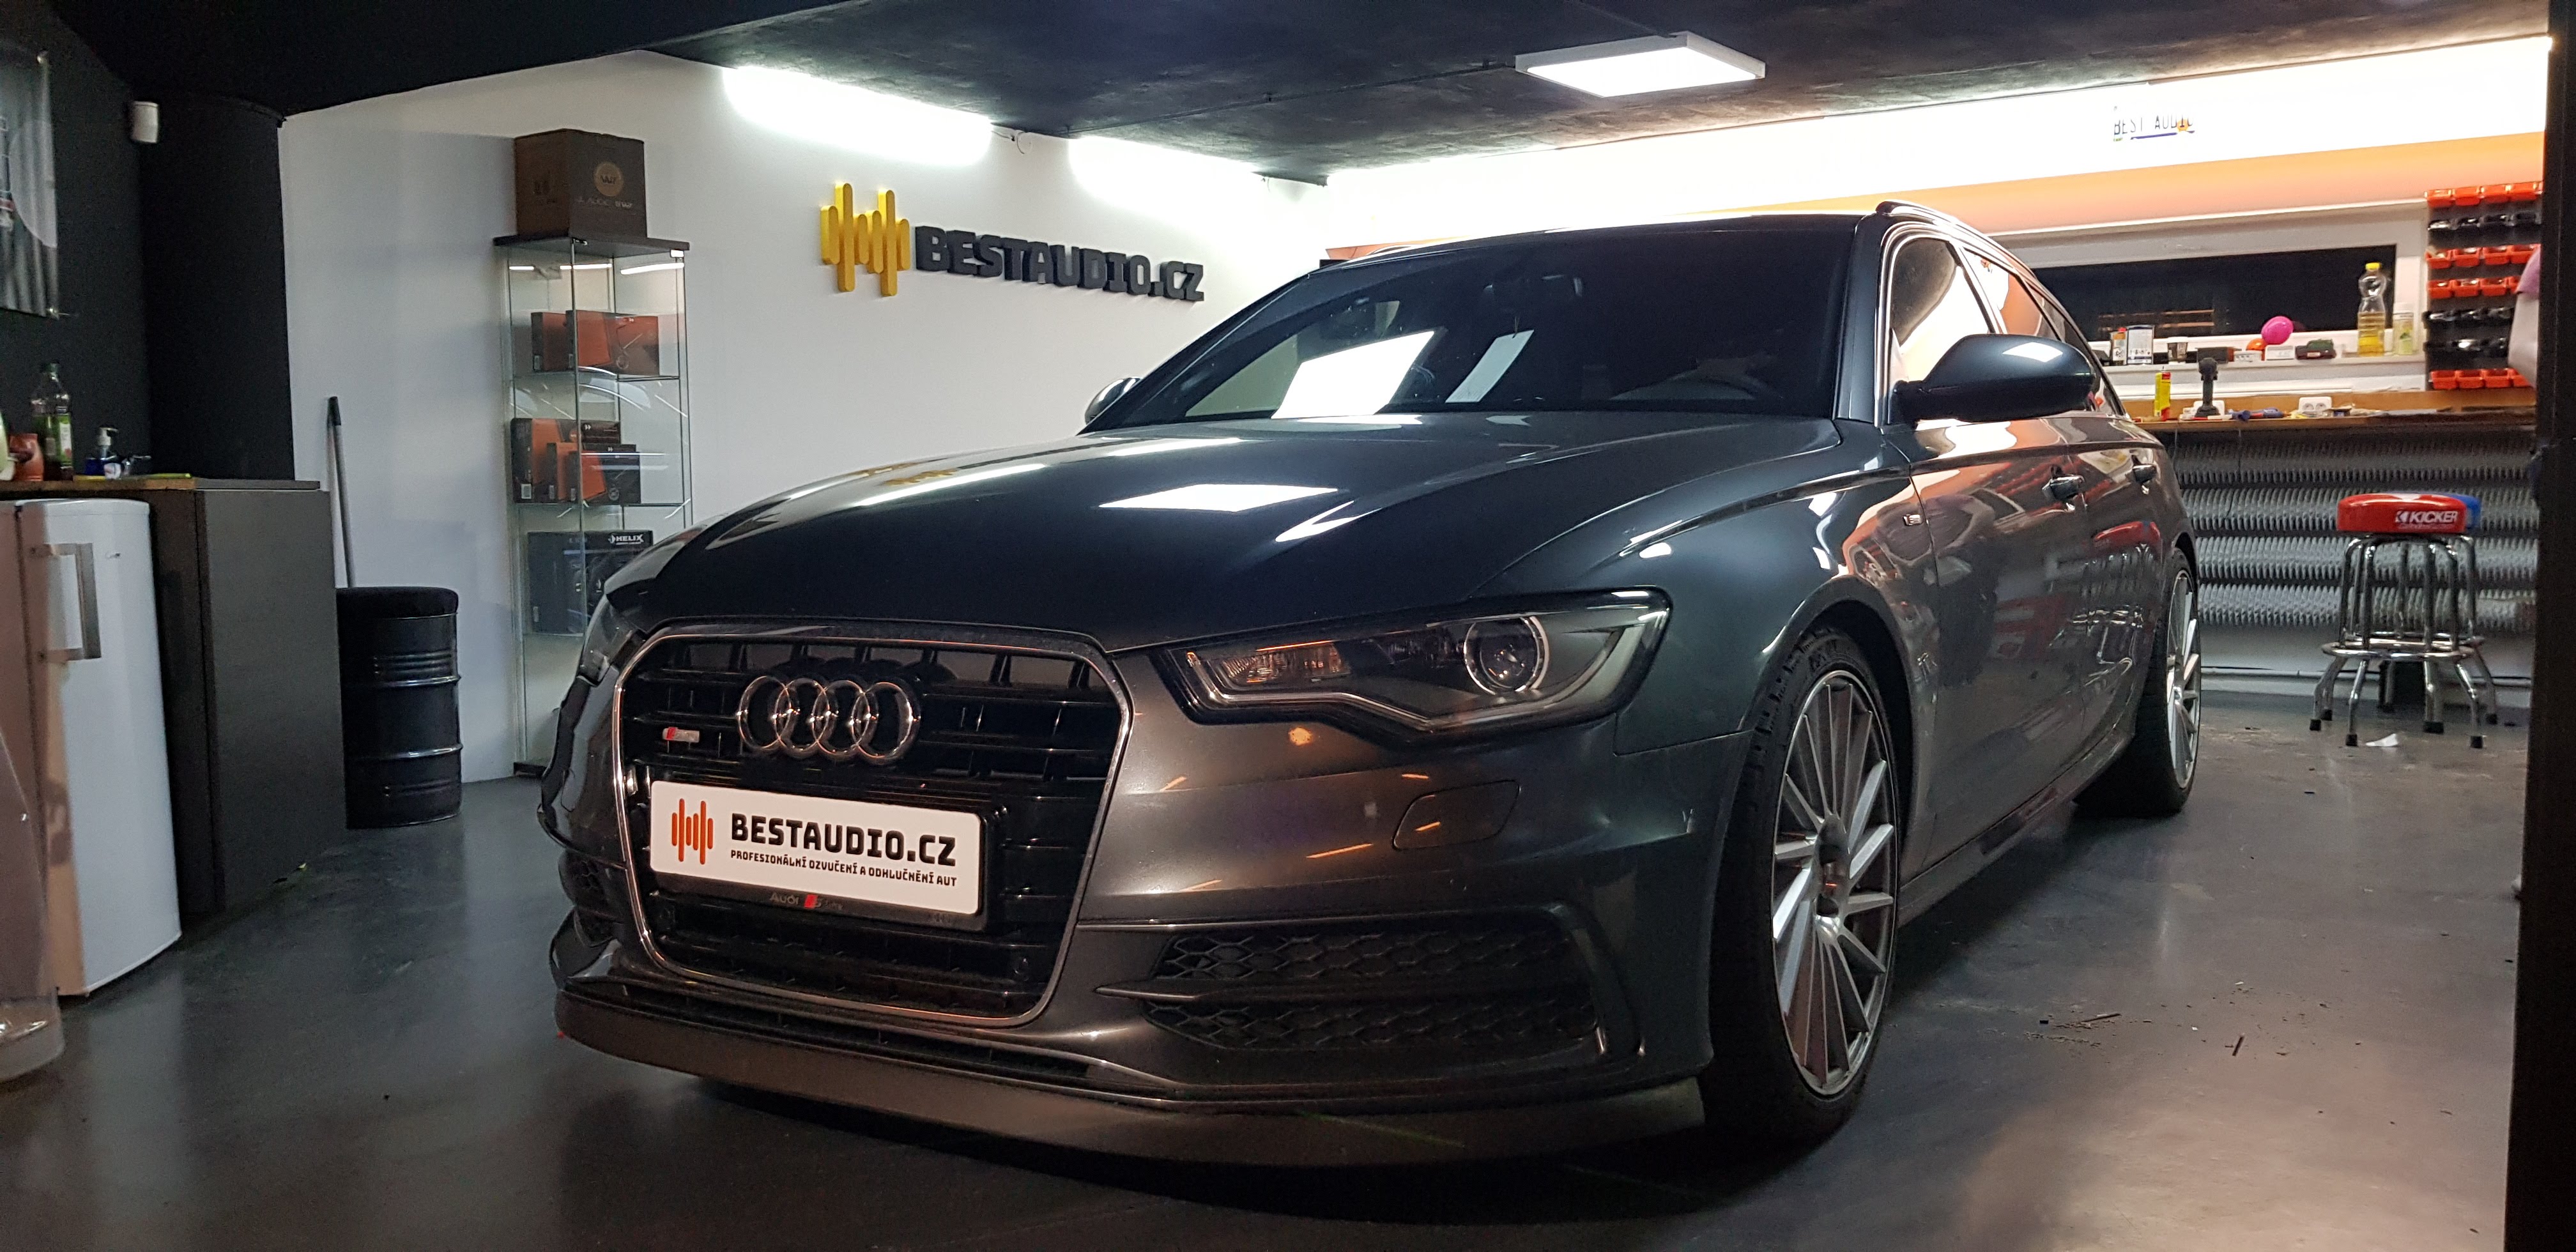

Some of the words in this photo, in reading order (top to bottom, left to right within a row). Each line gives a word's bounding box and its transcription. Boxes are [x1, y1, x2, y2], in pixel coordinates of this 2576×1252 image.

[915, 225, 1204, 301] BESTAUDIO.CZ
[2409, 510, 2458, 523] KICKER
[615, 533, 644, 544] HELIX
[731, 813, 956, 867] BESTAUDIO.CZ
[730, 849, 807, 868] PROFESIONÁLNÍ
[809, 859, 858, 874] OZVUČENÍ
[859, 866, 866, 875] A
[868, 867, 934, 884] ODHLUČNĚNÍ
[937, 875, 957, 887] AUT
